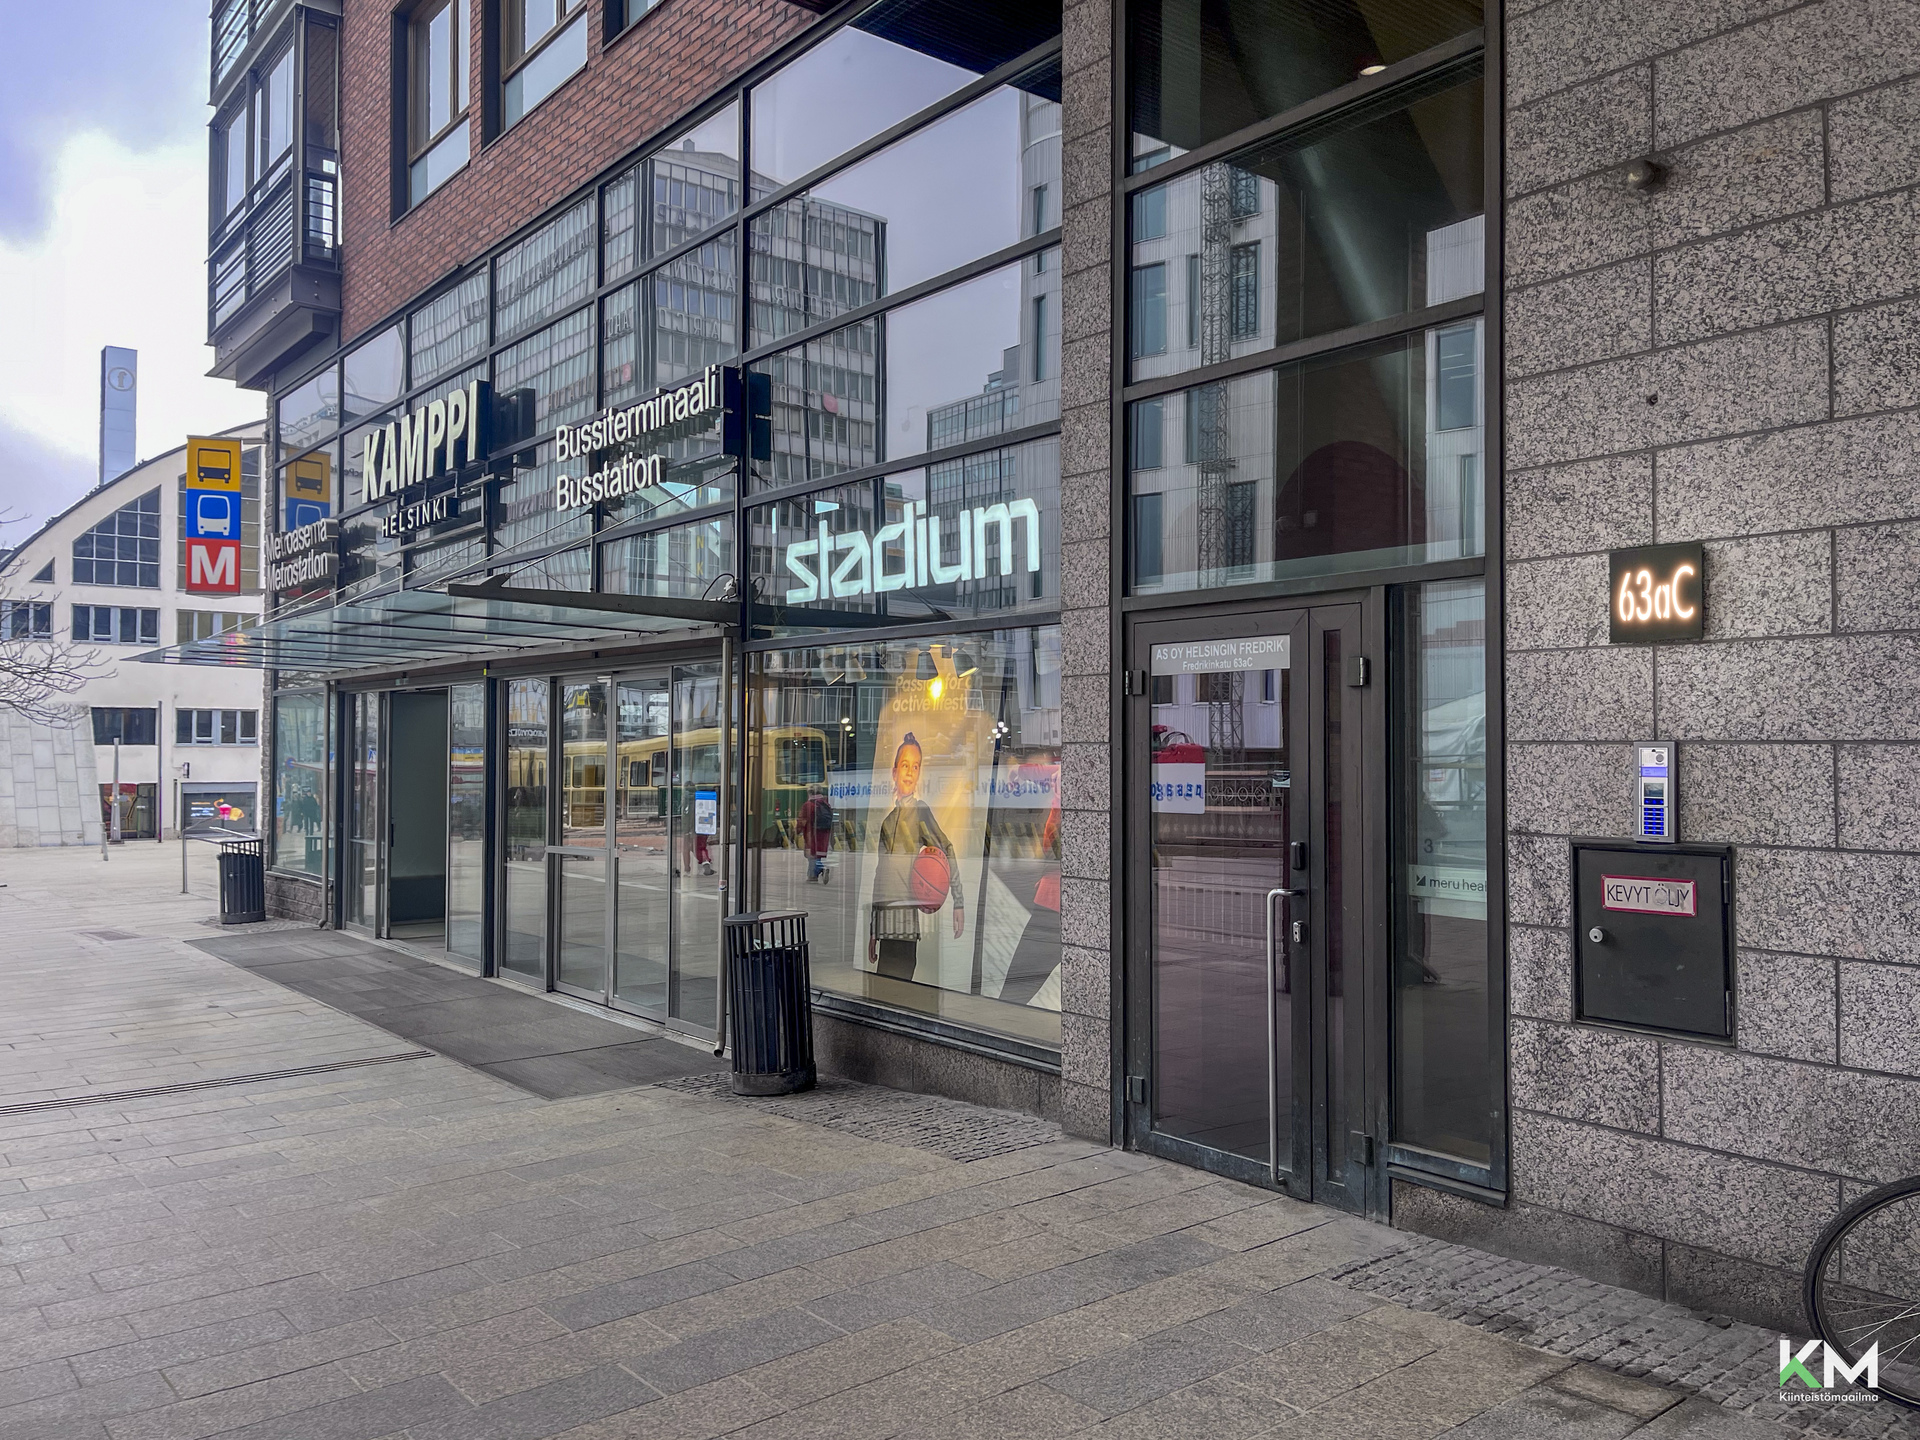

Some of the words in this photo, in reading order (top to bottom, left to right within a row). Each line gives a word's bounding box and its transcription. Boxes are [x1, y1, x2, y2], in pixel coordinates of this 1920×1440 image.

[555, 363, 717, 463] Bussiterminaali
[361, 379, 480, 504] KAMPPI
[556, 451, 661, 512] Busstation
[381, 496, 448, 537] HELSINKI
[265, 517, 328, 562] Metroasema
[785, 498, 1040, 605] stadium
[191, 545, 235, 586] M
[266, 549, 328, 592] Metrostation
[1619, 565, 1694, 622] 63aC
[1156, 648, 1169, 660] AS
[1170, 647, 1184, 659] OY
[1186, 643, 1236, 659] HELSINGIN
[1240, 640, 1284, 655] FREDRIK
[1183, 659, 1232, 671] Fredrikinkatu
[1233, 657, 1254, 668] 63aC
[892, 694, 930, 712] active
[1429, 878, 1460, 891] meru
[1607, 884, 1651, 904] KEVYT
[1654, 883, 1690, 908] ÖLJY
